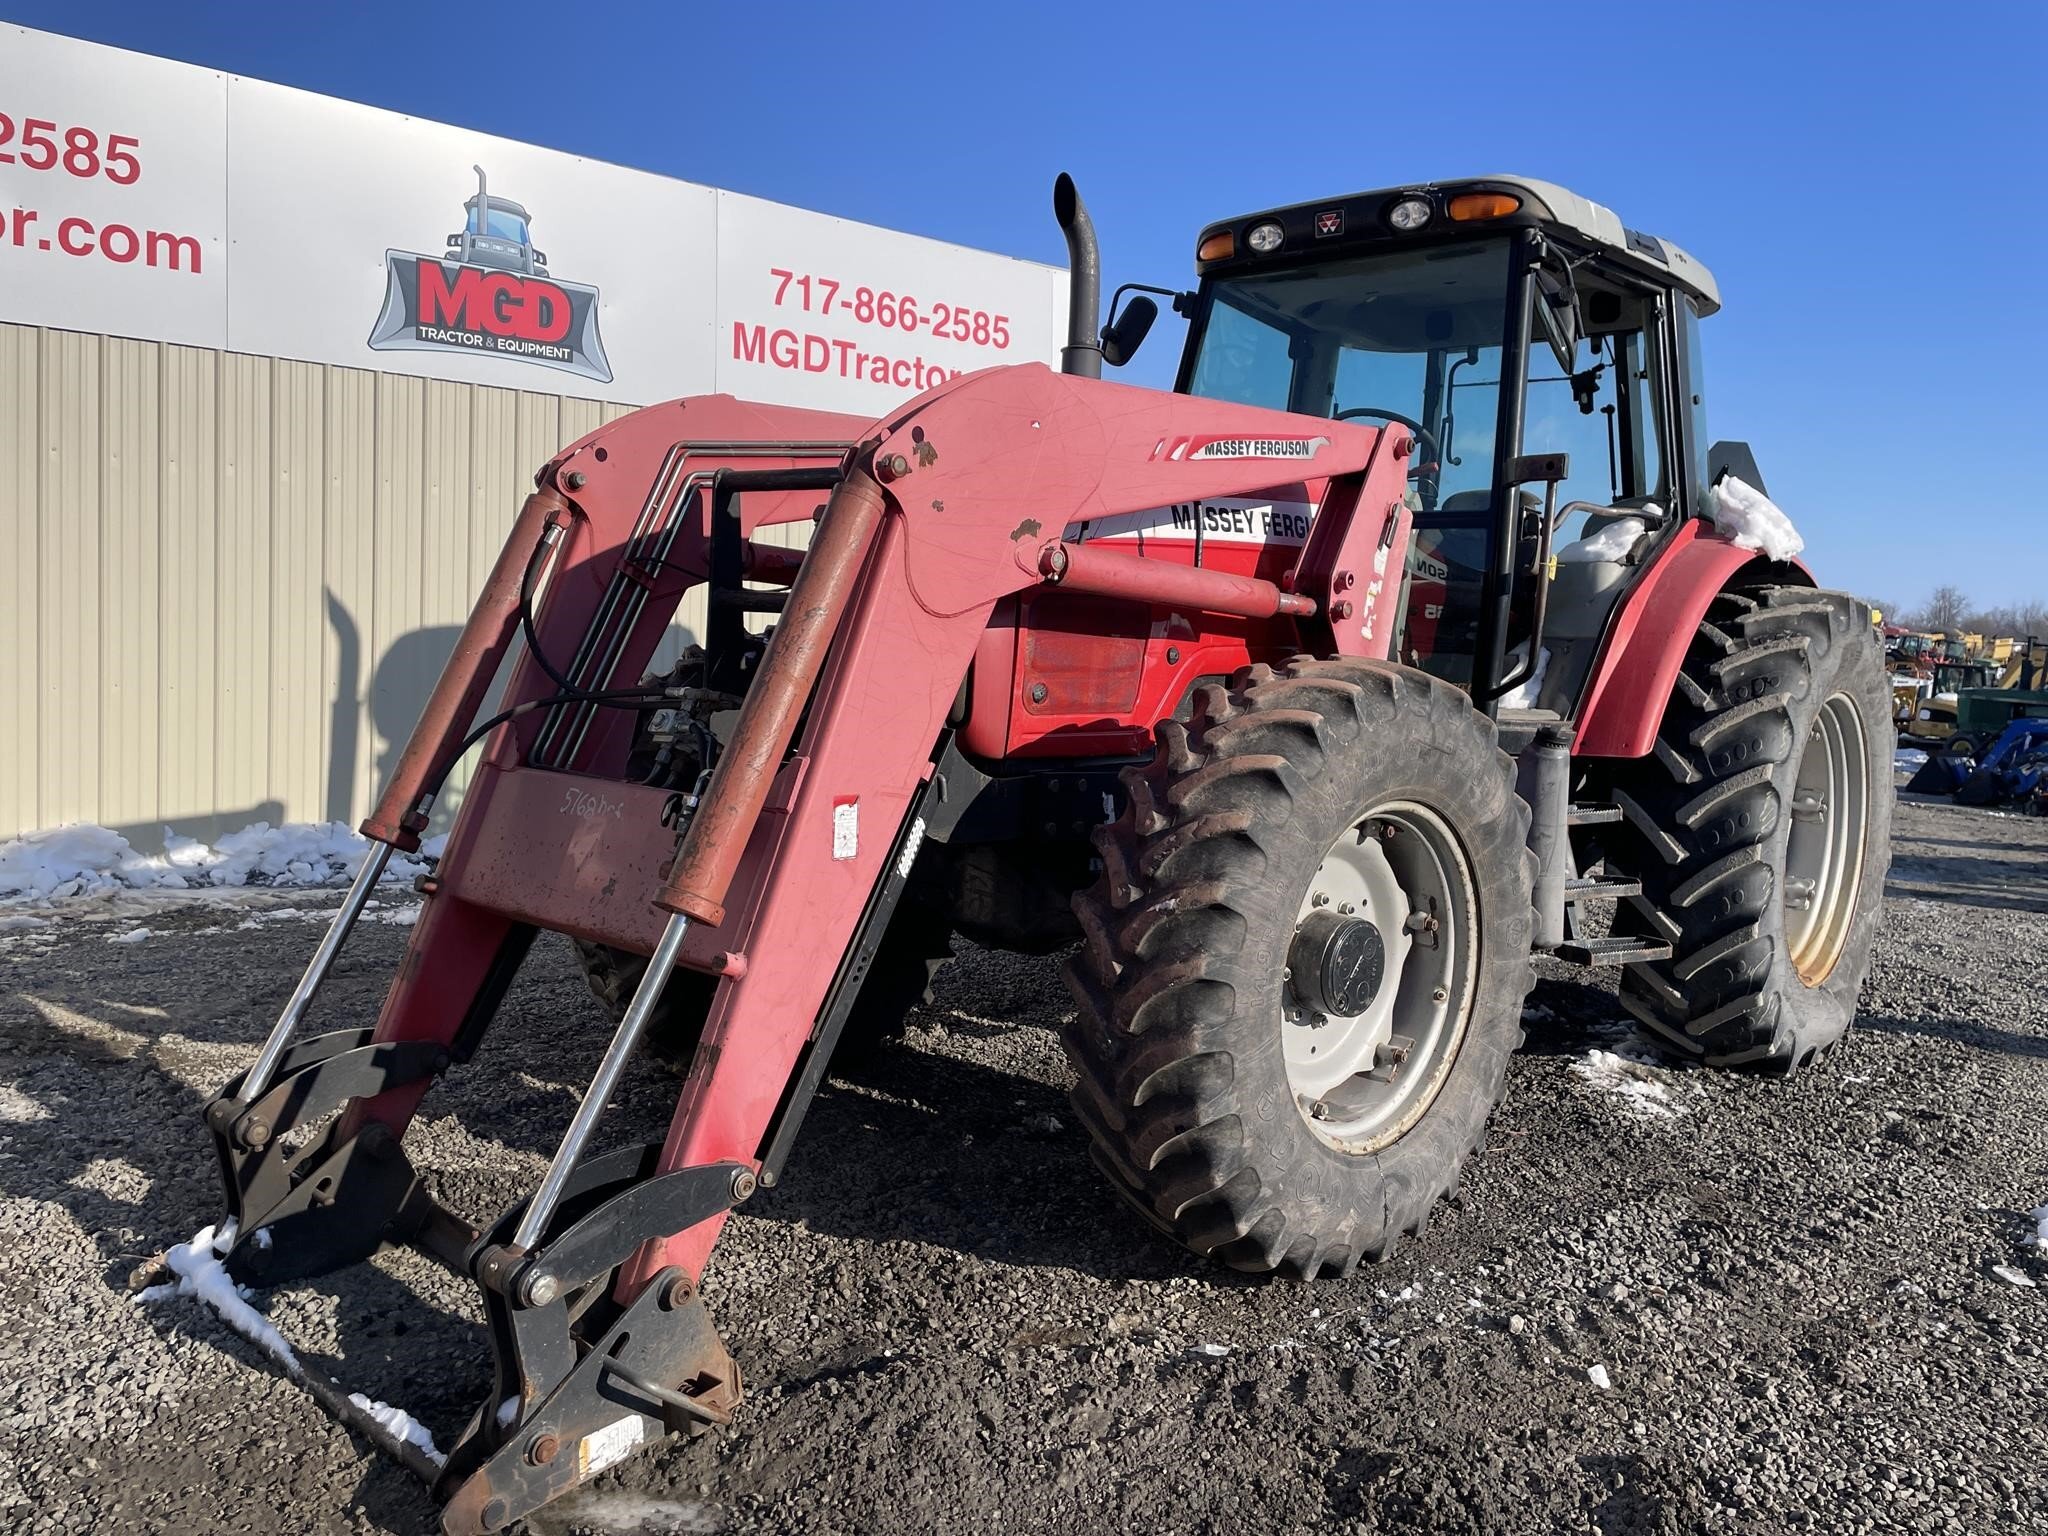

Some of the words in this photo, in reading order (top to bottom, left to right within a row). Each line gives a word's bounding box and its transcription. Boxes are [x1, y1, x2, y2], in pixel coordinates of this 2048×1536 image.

[0, 208, 202, 274] r.com
[418, 260, 572, 343] MGD
[770, 267, 1010, 349] 717-866-2585
[419, 326, 483, 347] TRACTOR
[485, 337, 495, 348] &
[497, 338, 571, 360] EQUIPMENT
[1204, 440, 1251, 456] MASSEY
[1254, 440, 1309, 456] FERGUSON
[1260, 511, 1311, 539] FERG
